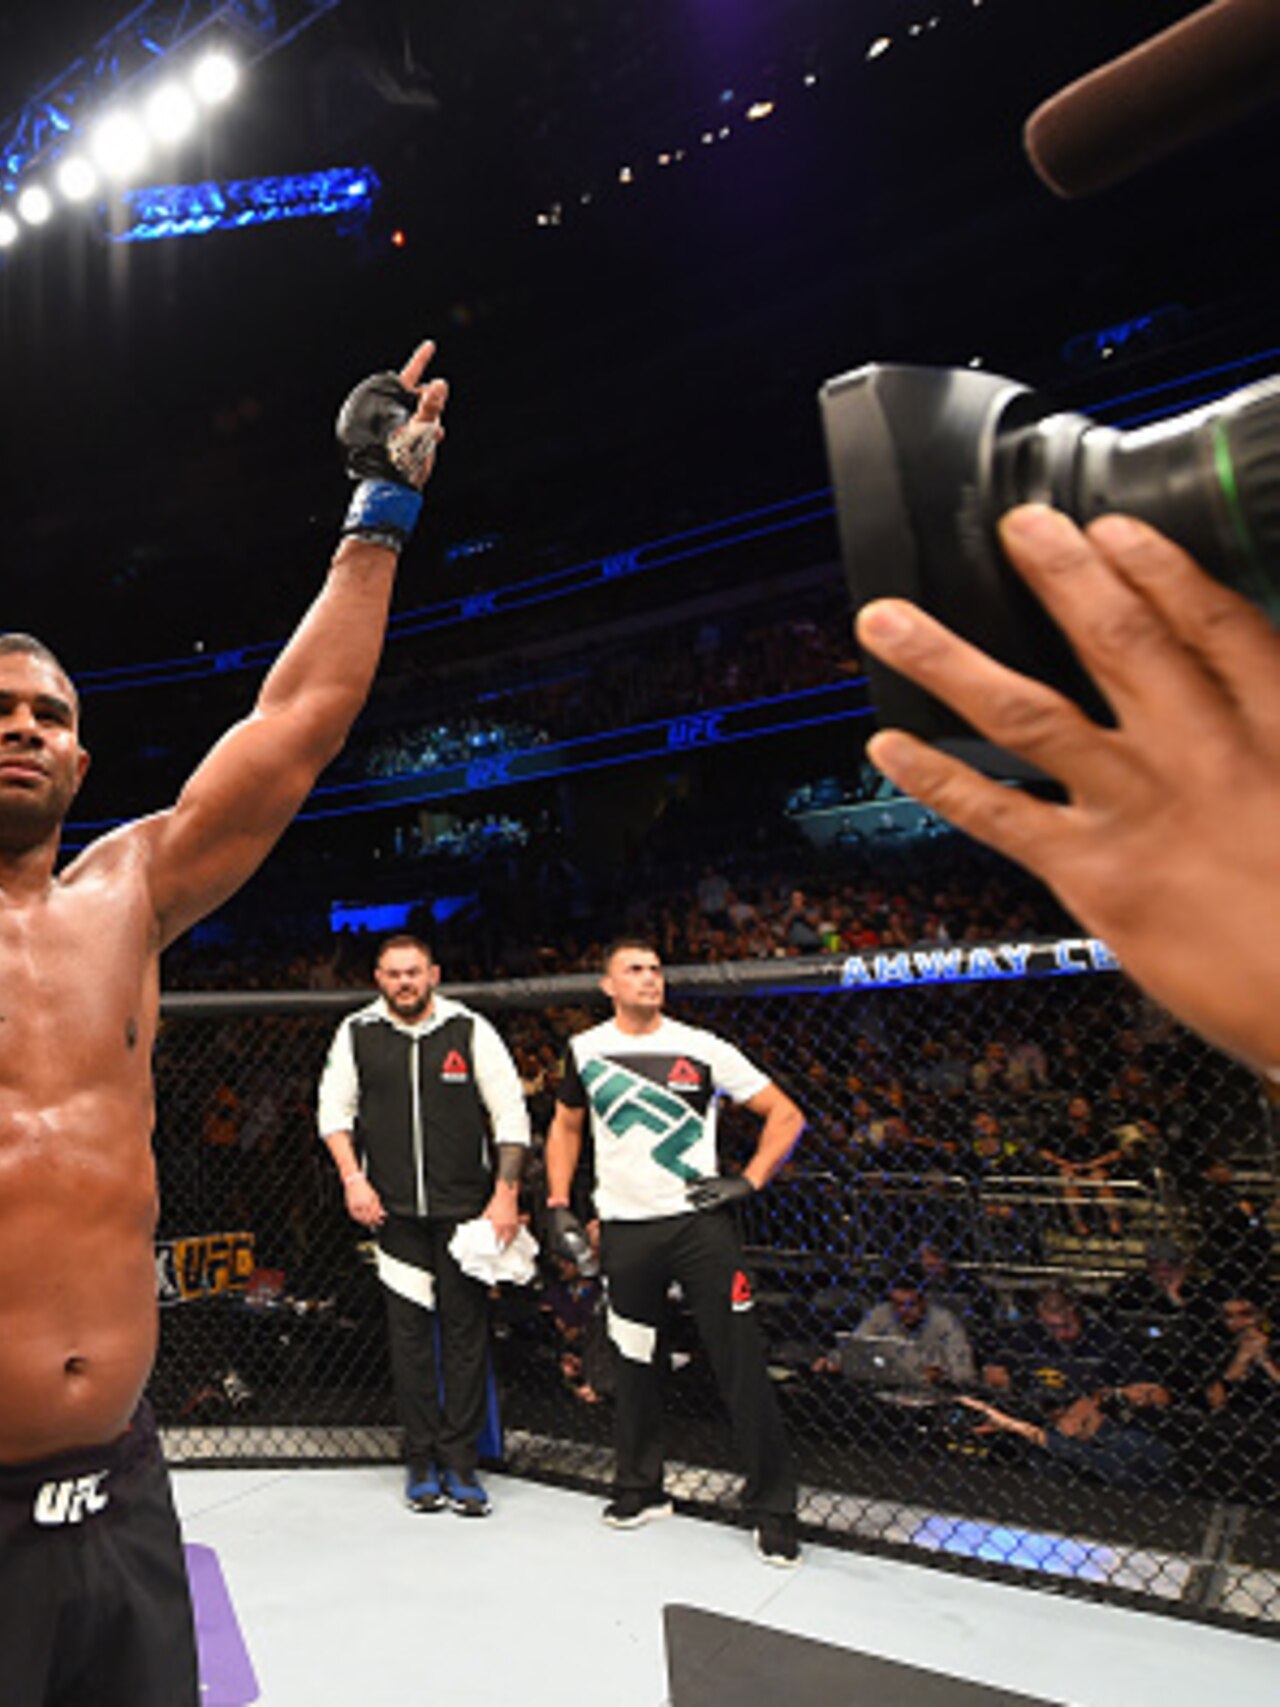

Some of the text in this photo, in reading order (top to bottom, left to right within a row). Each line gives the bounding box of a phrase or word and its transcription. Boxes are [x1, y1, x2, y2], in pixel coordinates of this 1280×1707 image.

[667, 714, 726, 751] UFC
[840, 942, 1033, 987] AMWAY
[580, 1059, 703, 1182] UFC
[34, 1470, 109, 1525] UFC
